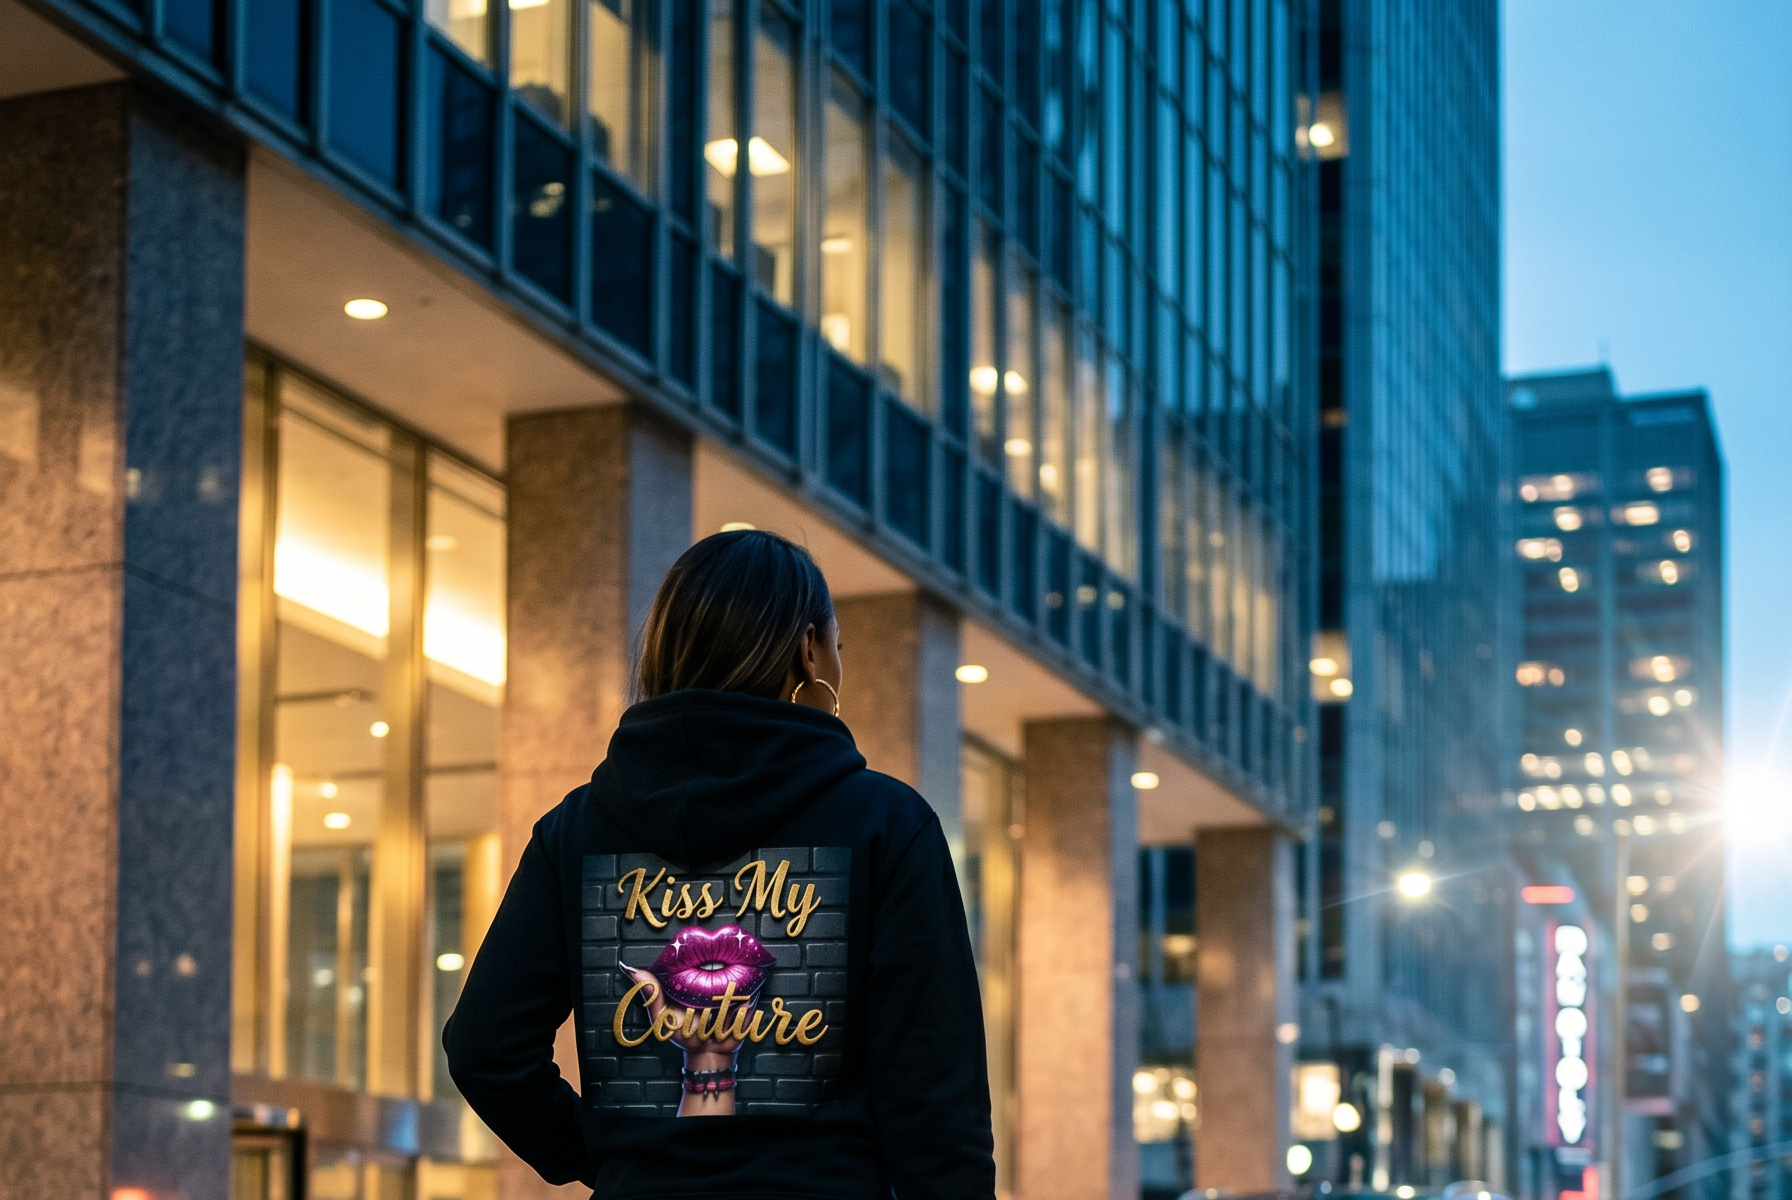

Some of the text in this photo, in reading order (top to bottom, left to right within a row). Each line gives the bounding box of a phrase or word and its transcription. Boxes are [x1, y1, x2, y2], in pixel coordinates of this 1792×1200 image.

[617, 860, 821, 937] Kiss My
[613, 981, 828, 1047] Couture
